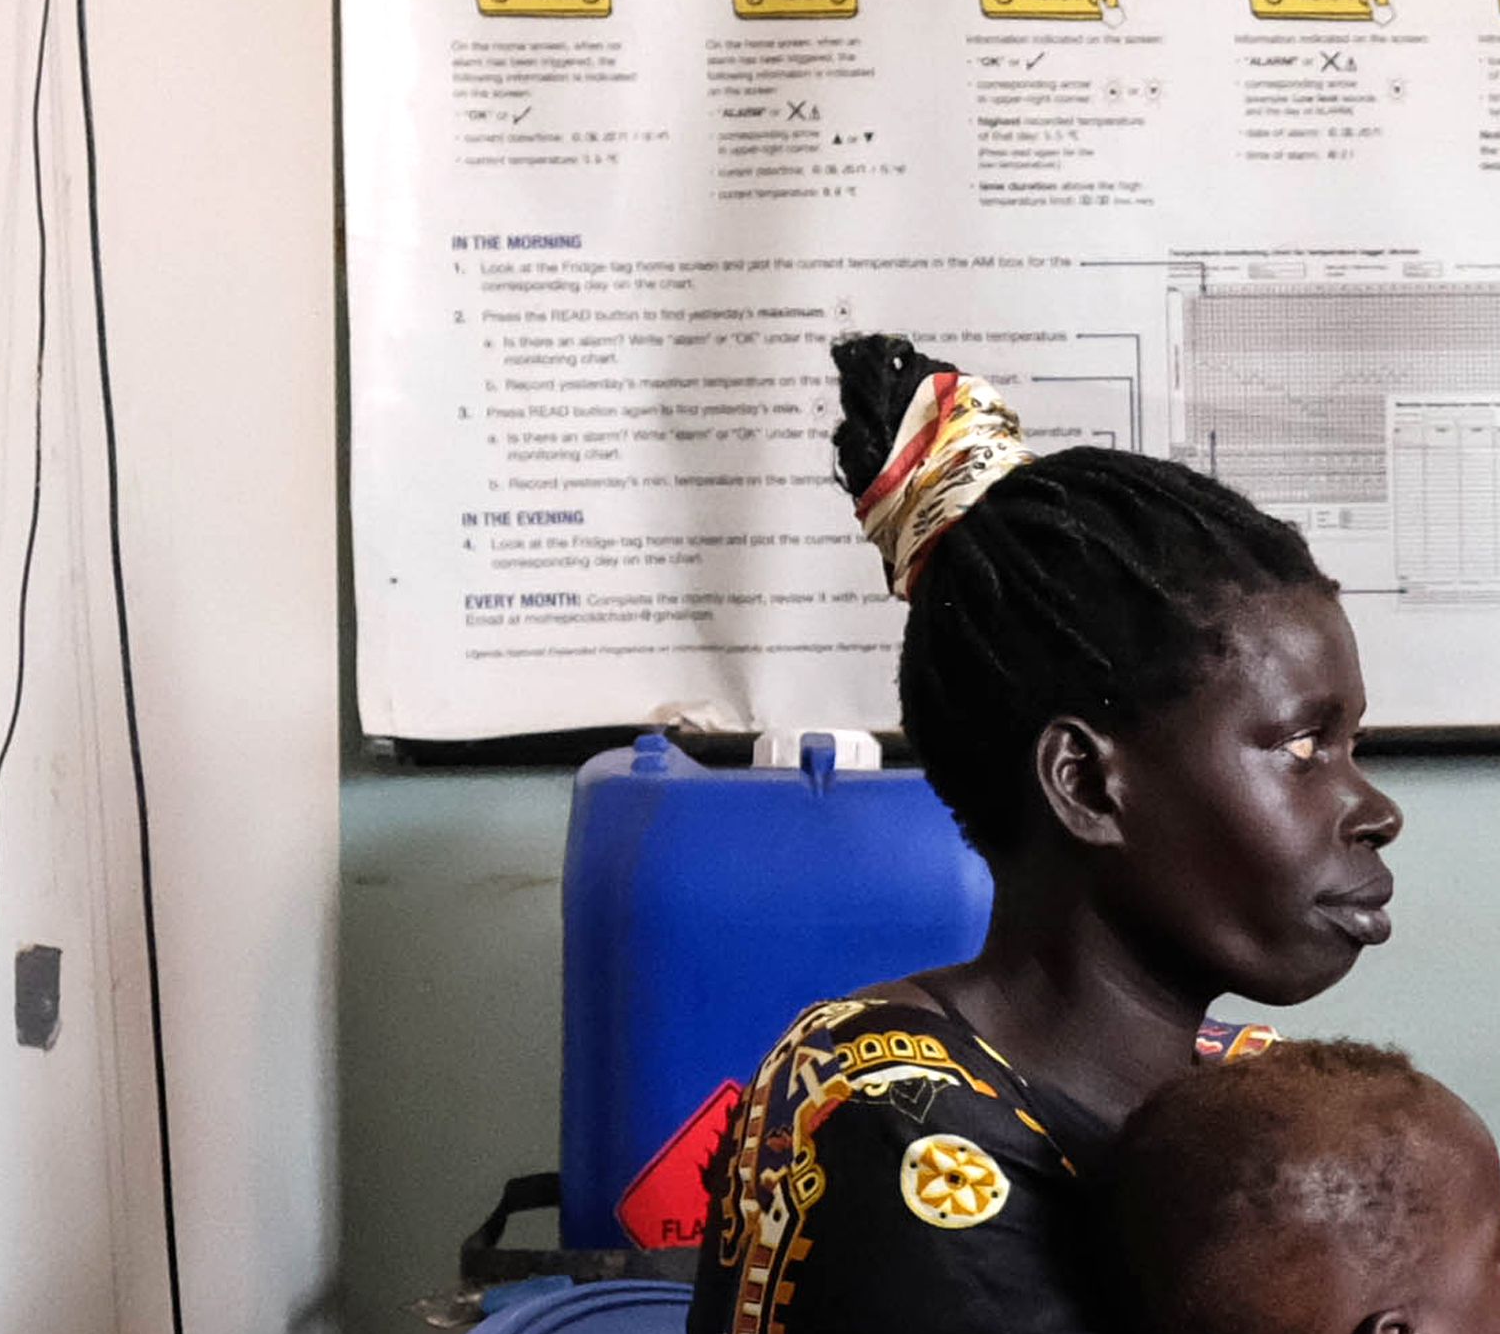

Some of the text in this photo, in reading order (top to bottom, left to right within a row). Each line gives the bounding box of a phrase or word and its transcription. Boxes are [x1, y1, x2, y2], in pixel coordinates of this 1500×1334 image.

[452, 235, 582, 250] IN THE MORNING
[662, 1219, 705, 1241] FLA
